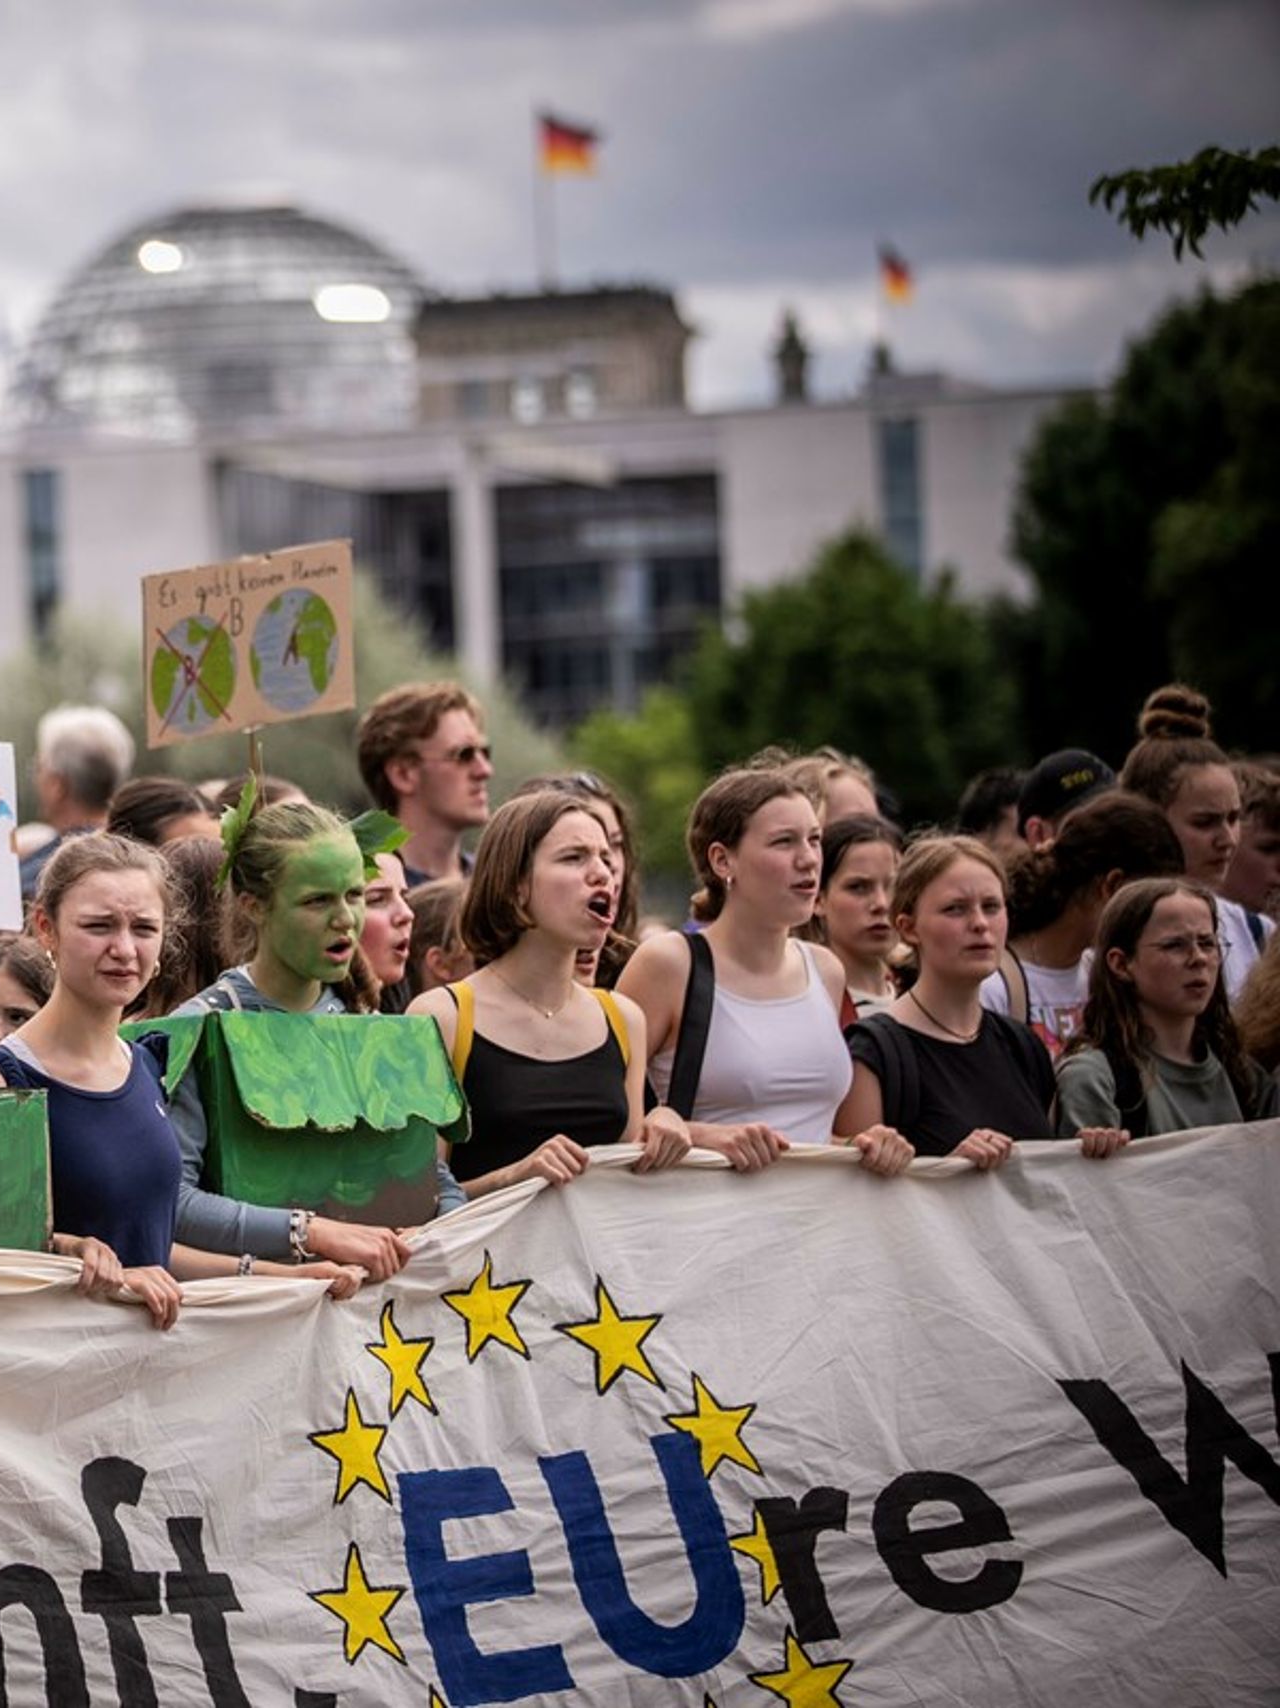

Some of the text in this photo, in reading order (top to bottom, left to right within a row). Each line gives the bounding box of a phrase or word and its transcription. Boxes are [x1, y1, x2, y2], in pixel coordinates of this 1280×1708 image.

[158, 579, 176, 608] Es
[195, 577, 231, 614] gibt
[230, 596, 244, 637] B
[396, 1429, 1024, 1706] EUre
